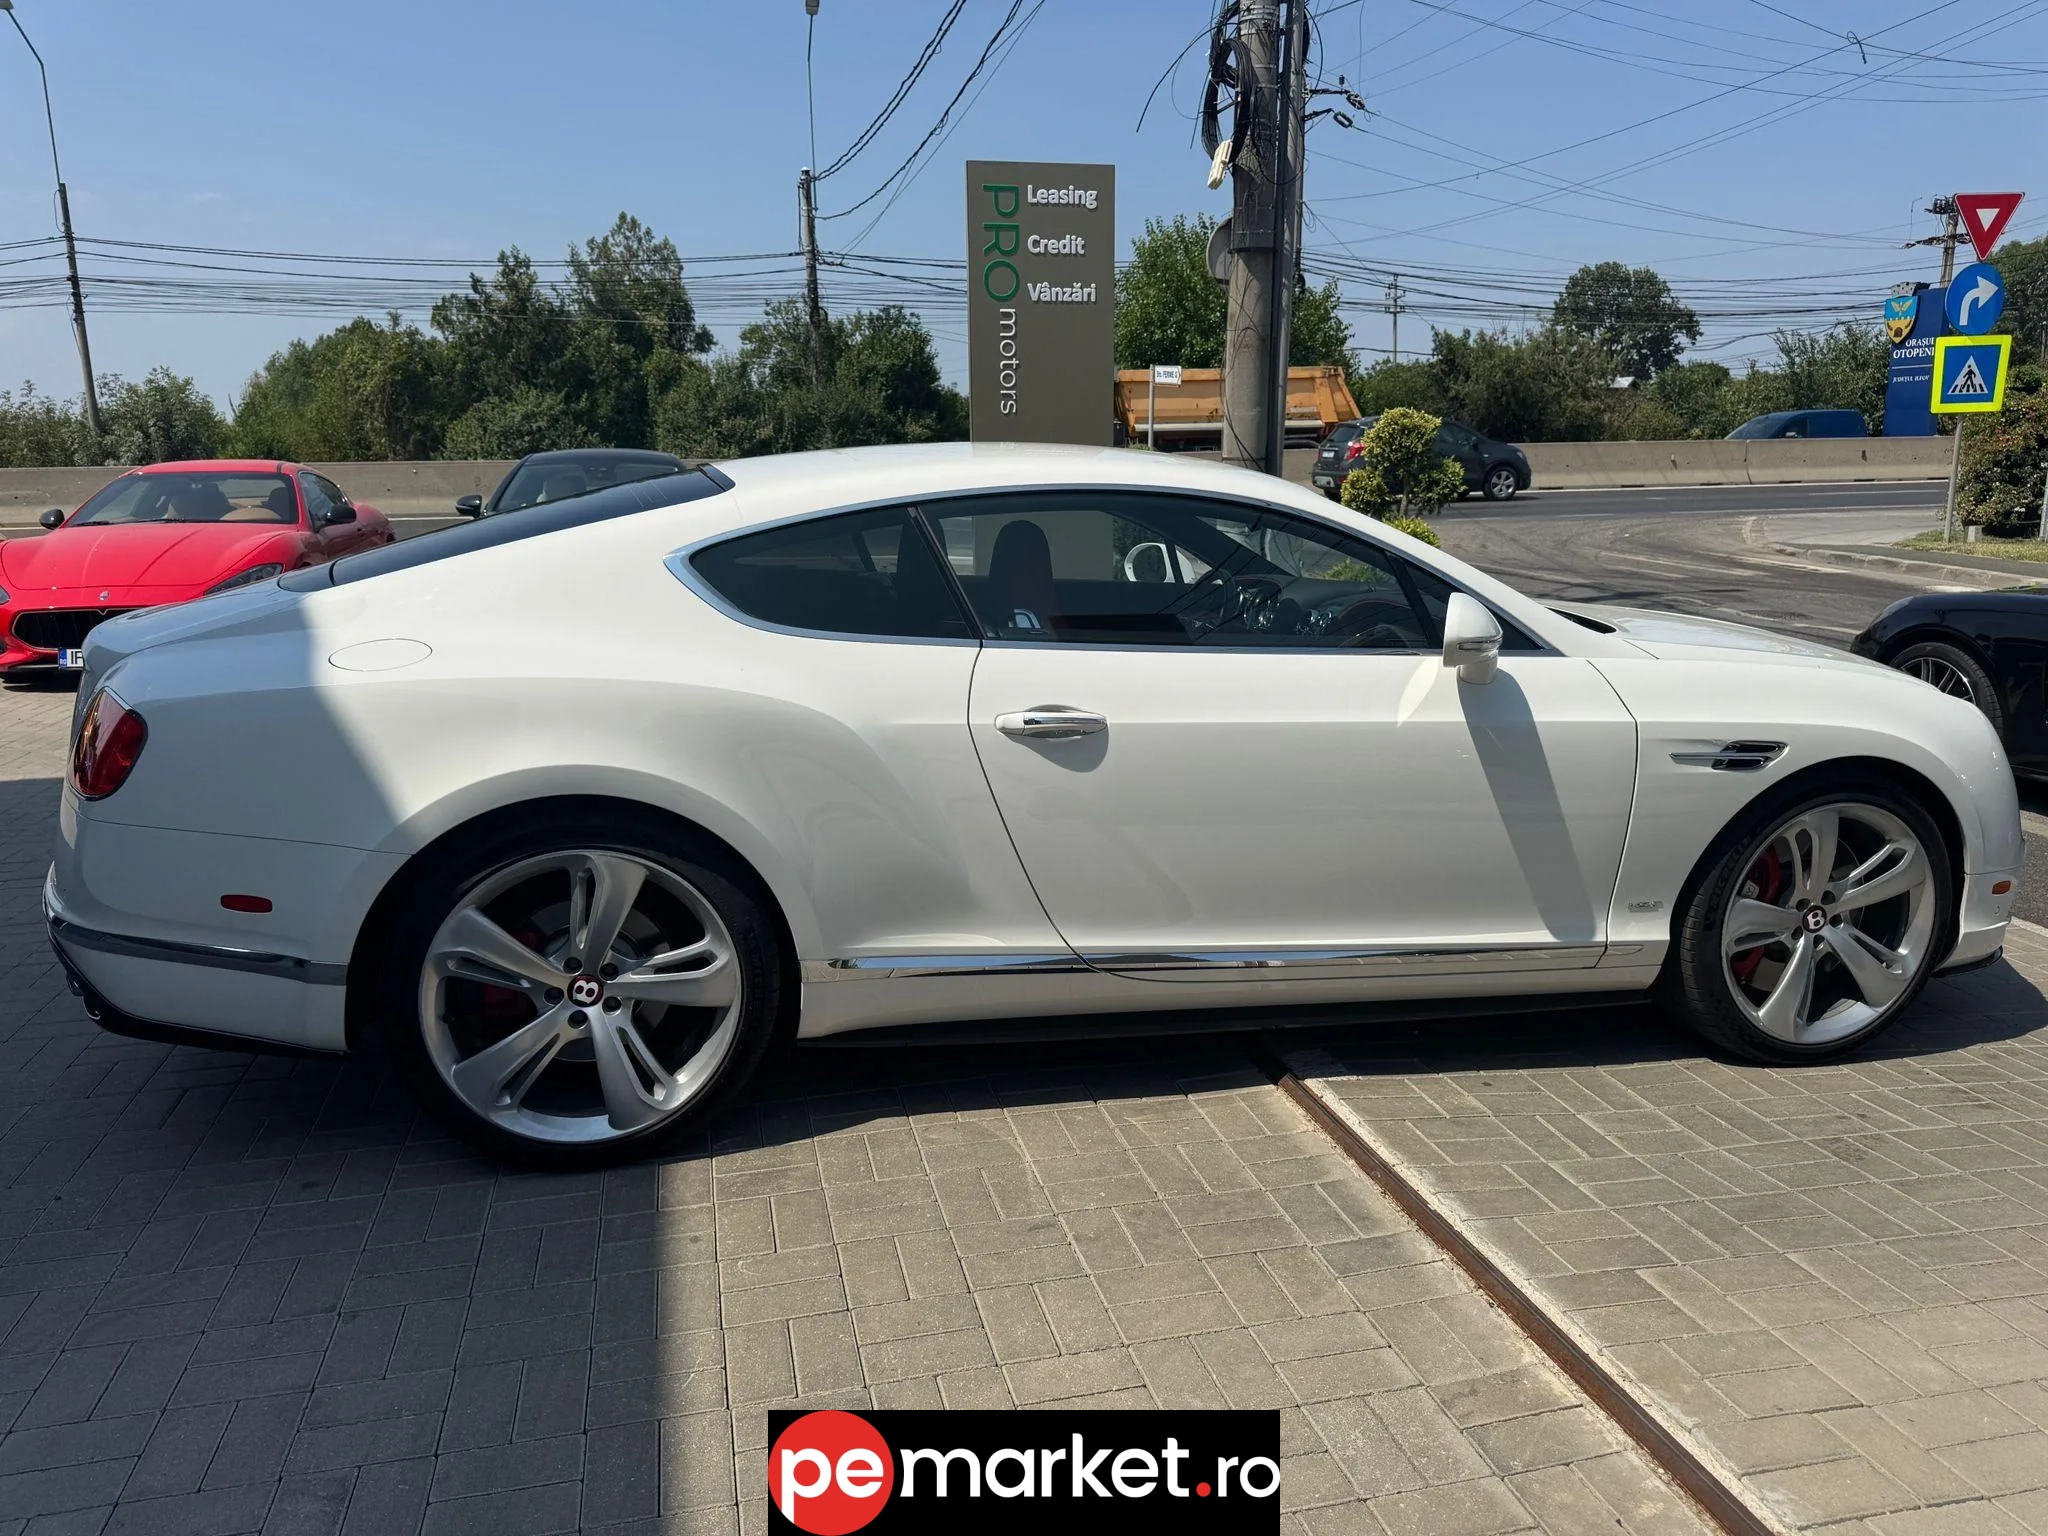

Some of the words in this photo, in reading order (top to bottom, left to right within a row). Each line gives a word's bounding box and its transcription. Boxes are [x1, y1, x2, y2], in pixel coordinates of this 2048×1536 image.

[1027, 185, 1098, 209] Leasing
[982, 184, 1020, 302] PRO
[1027, 235, 1085, 255] Credit
[1027, 282, 1097, 302] Vânzări
[1000, 308, 1019, 415] motors
